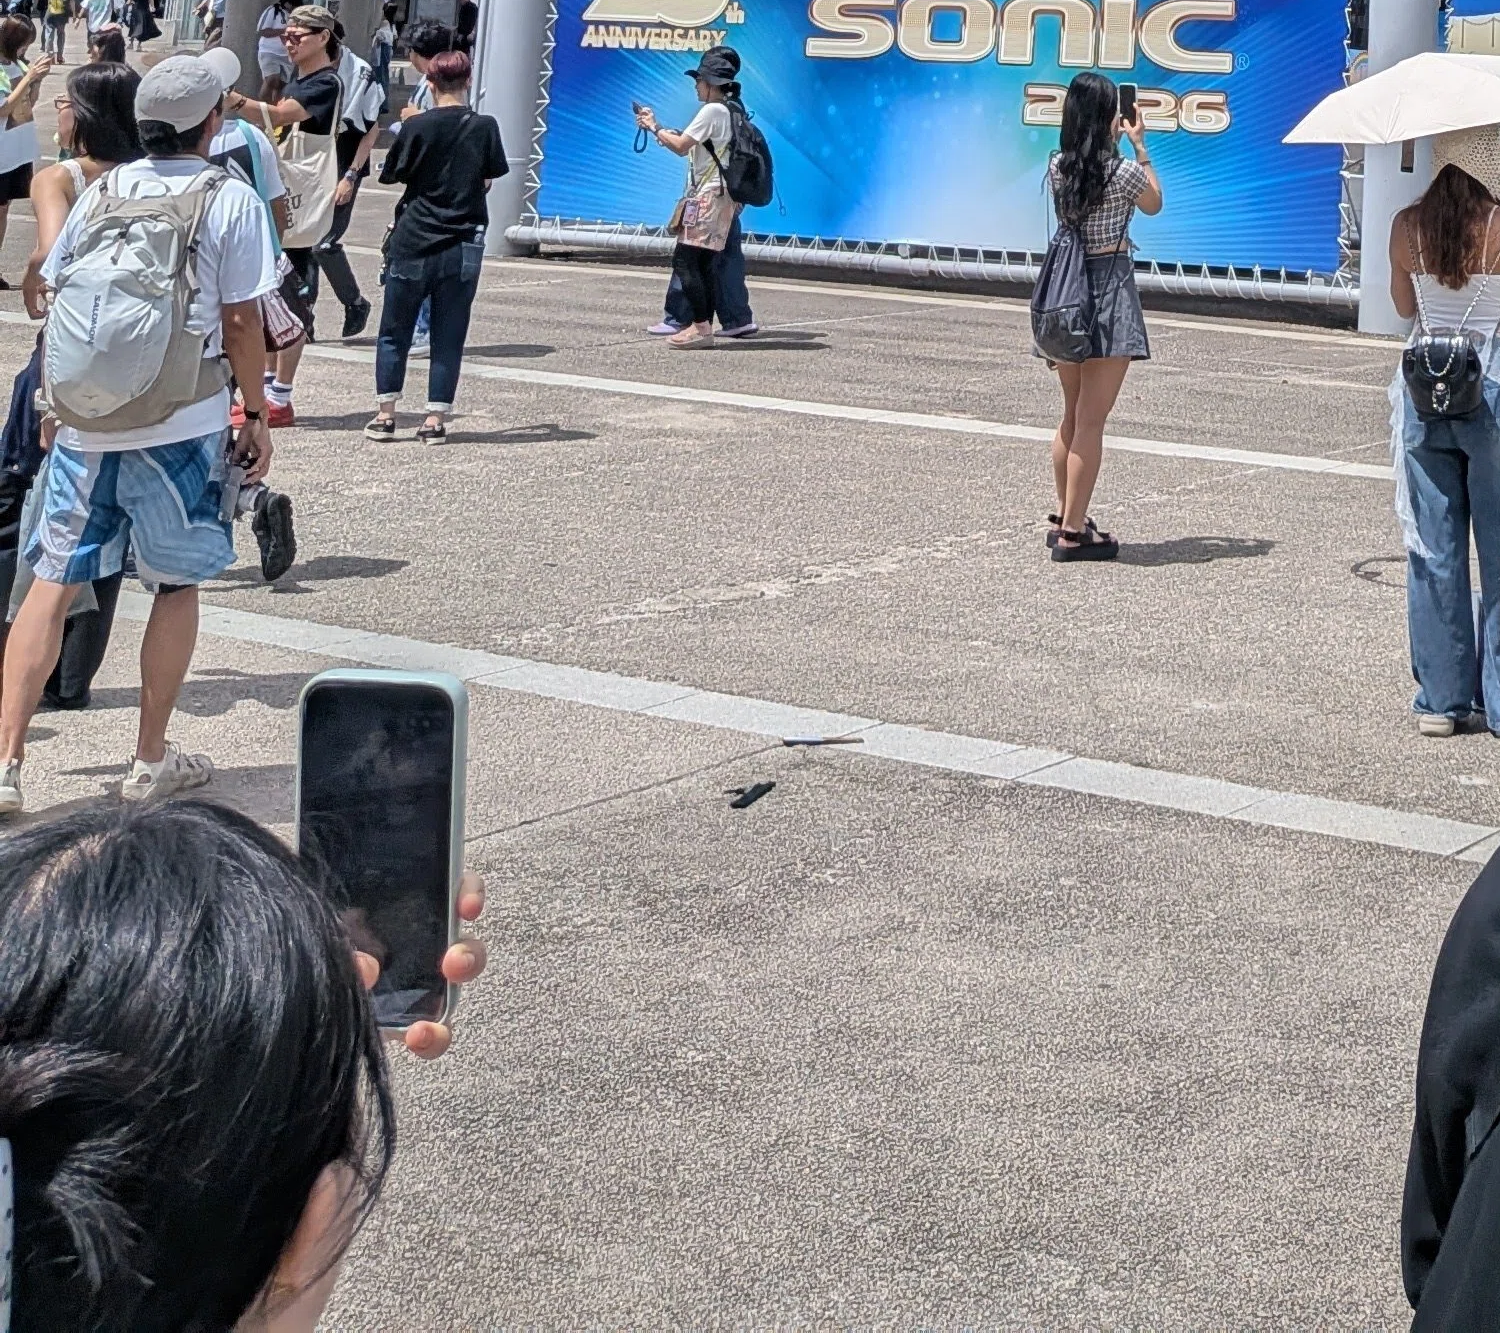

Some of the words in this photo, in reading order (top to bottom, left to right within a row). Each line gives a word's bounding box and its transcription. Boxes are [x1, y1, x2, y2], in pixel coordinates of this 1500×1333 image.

[581, 24, 727, 52] ANNIVERSARY
[1022, 82, 1231, 134] 226
[88, 295, 101, 345] SALOMON
